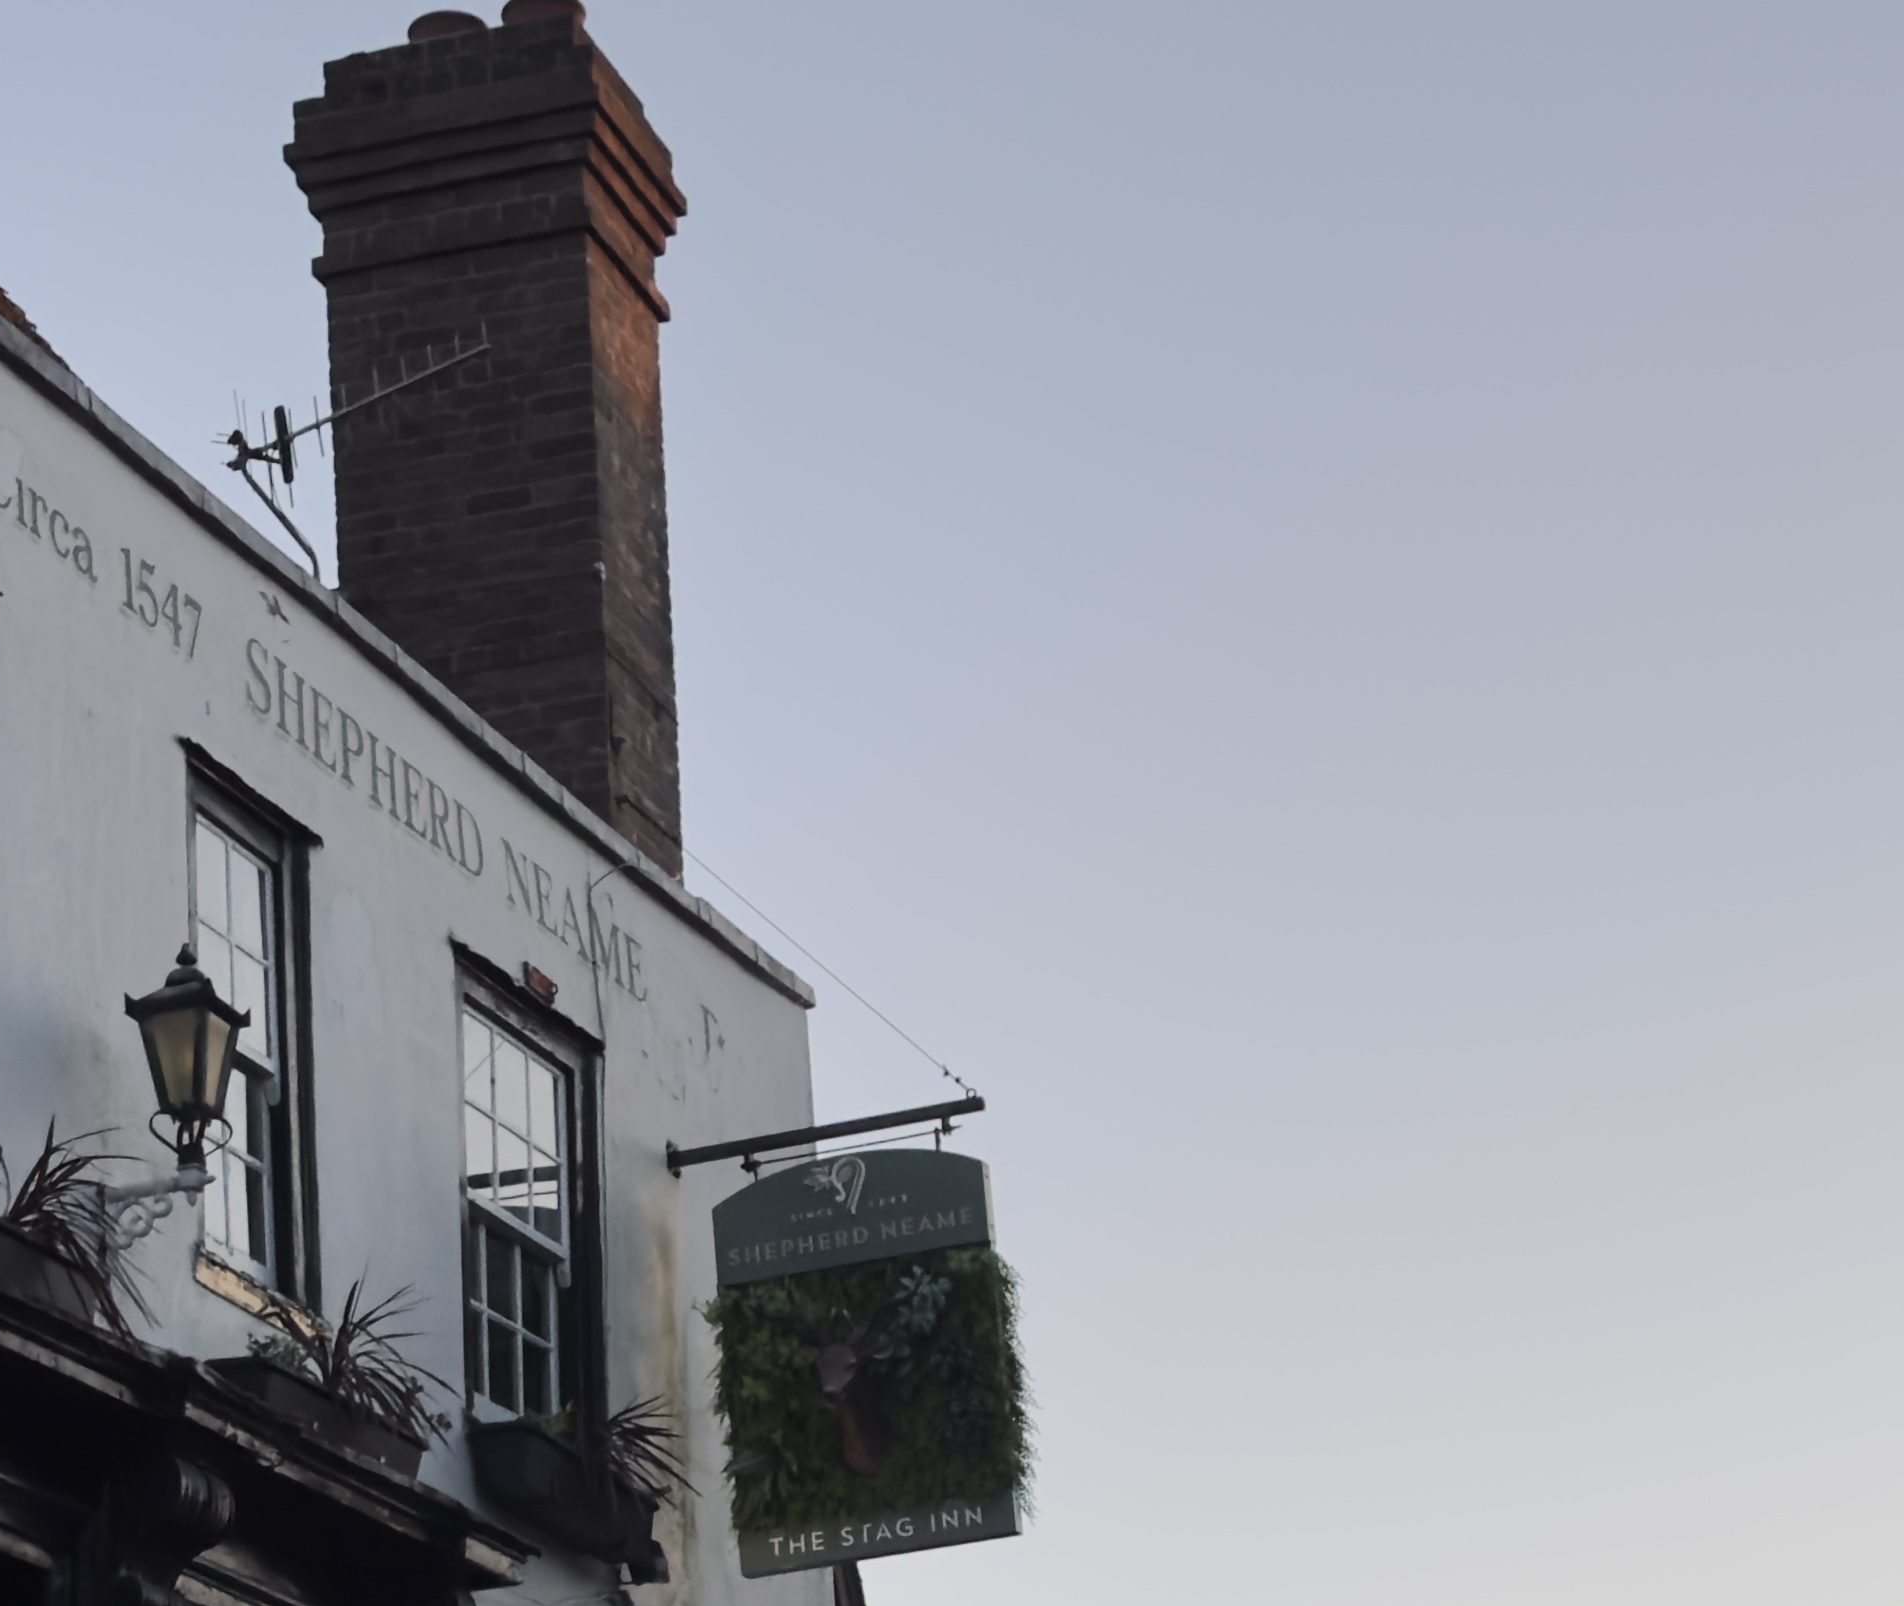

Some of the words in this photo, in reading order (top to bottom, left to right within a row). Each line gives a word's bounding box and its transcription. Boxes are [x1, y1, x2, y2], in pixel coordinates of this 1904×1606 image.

[120, 547, 202, 659] 1547
[246, 638, 484, 877] SHEPHERD
[501, 836, 648, 1002] NEAME
[728, 1226, 869, 1267] SHEPHERD
[881, 1207, 973, 1240] NEAME
[768, 1531, 825, 1557] THE
[840, 1516, 915, 1547] STAG
[930, 1506, 983, 1532] INN
